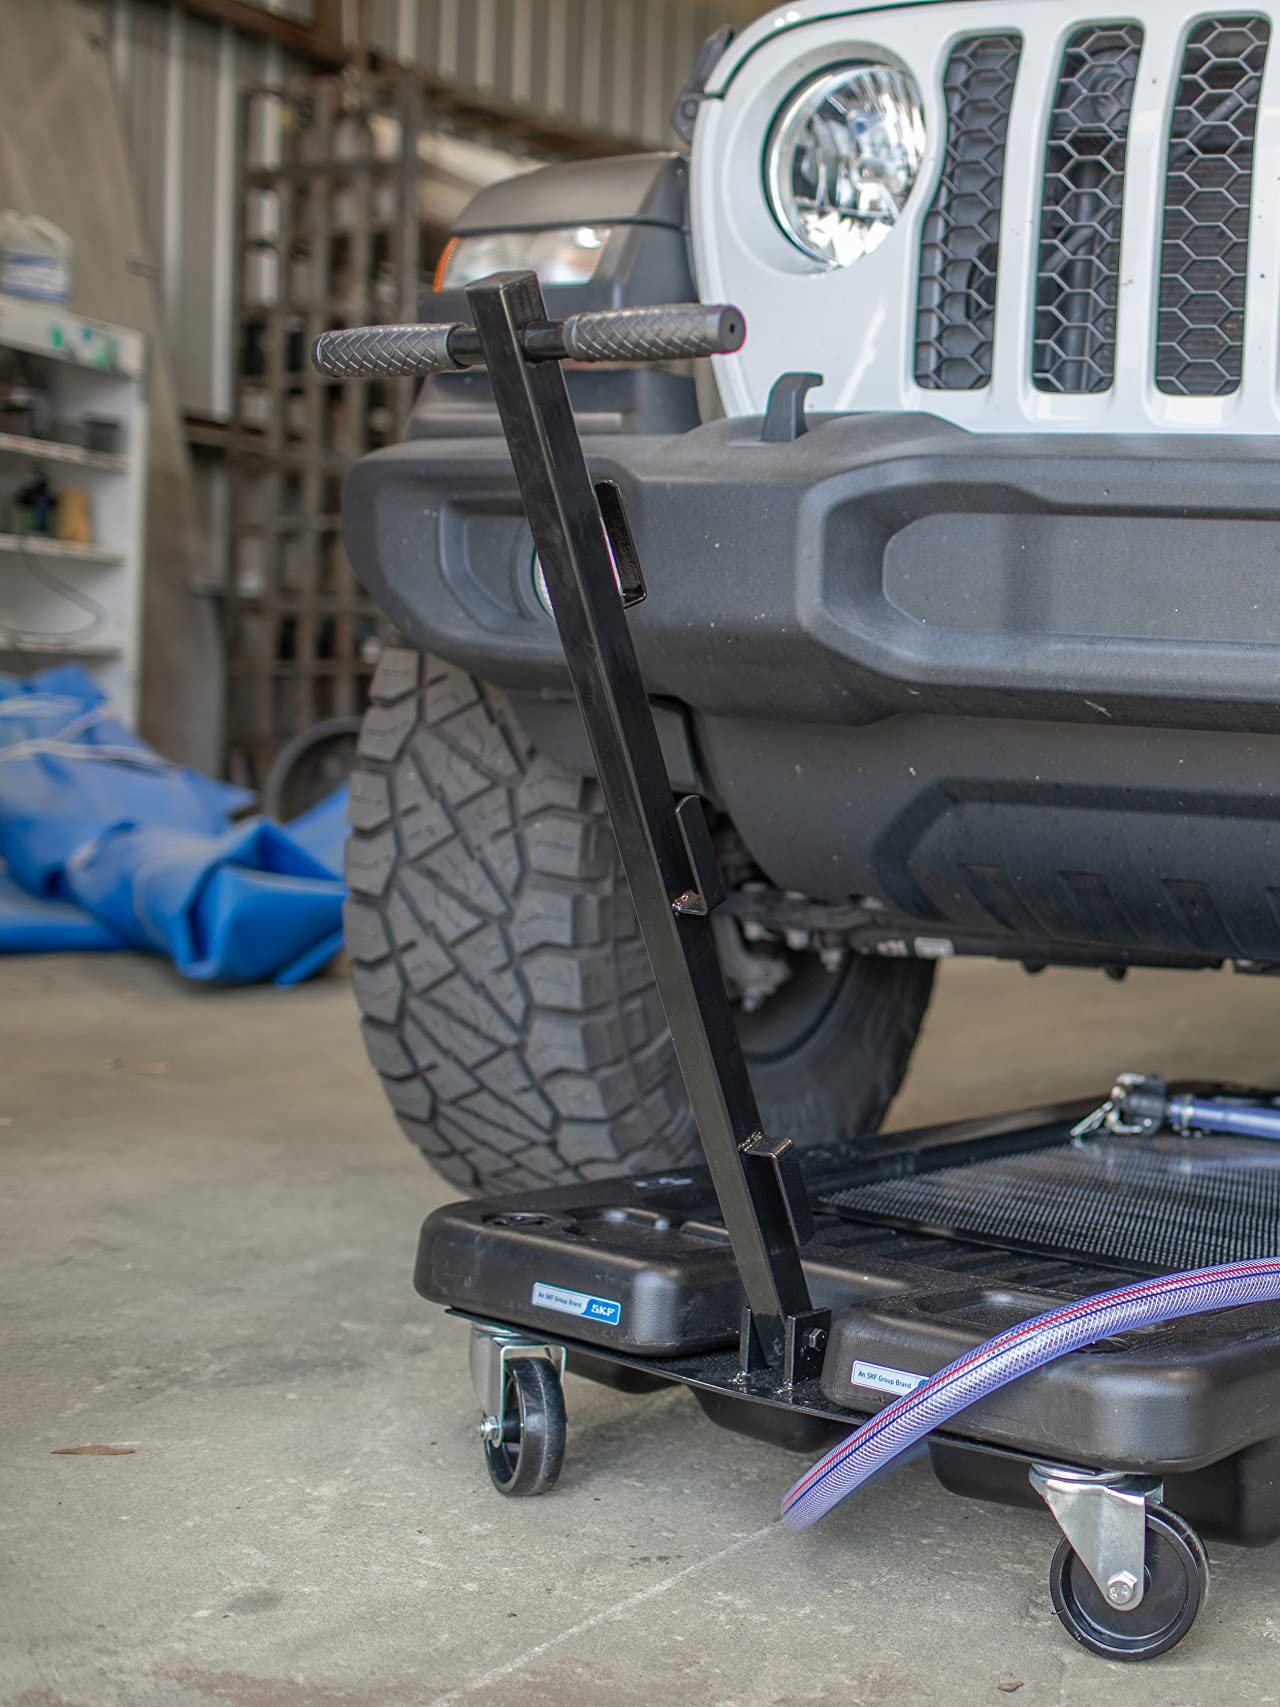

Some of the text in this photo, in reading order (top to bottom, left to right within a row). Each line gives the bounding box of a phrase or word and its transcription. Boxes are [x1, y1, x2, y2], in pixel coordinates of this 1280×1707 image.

[555, 1295, 568, 1305] Group
[591, 1304, 616, 1317] SKF
[858, 1370, 912, 1389] An SKF Group Brand
